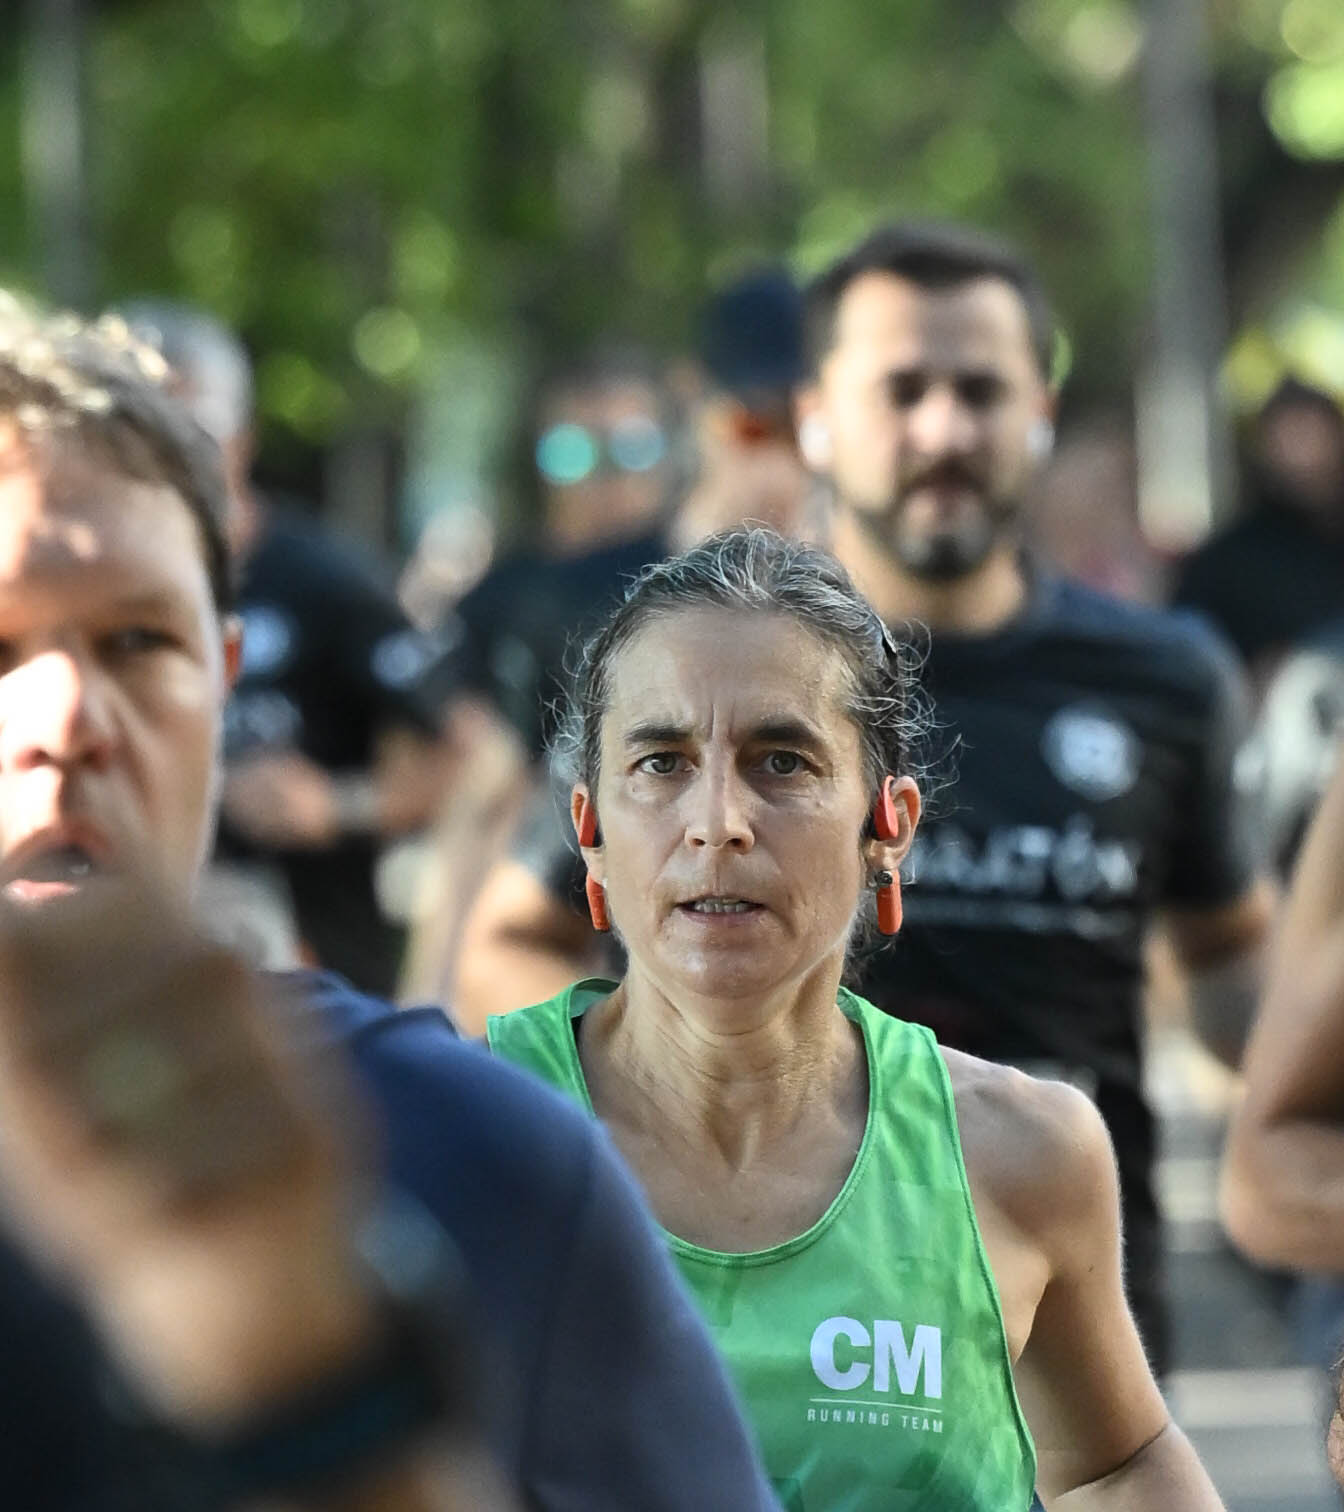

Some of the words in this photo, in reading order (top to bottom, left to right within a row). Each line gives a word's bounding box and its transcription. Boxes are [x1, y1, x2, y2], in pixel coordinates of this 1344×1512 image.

[810, 1316, 942, 1399] CM
[807, 1408, 890, 1426] RUNNING
[901, 1416, 943, 1433] TEAM
